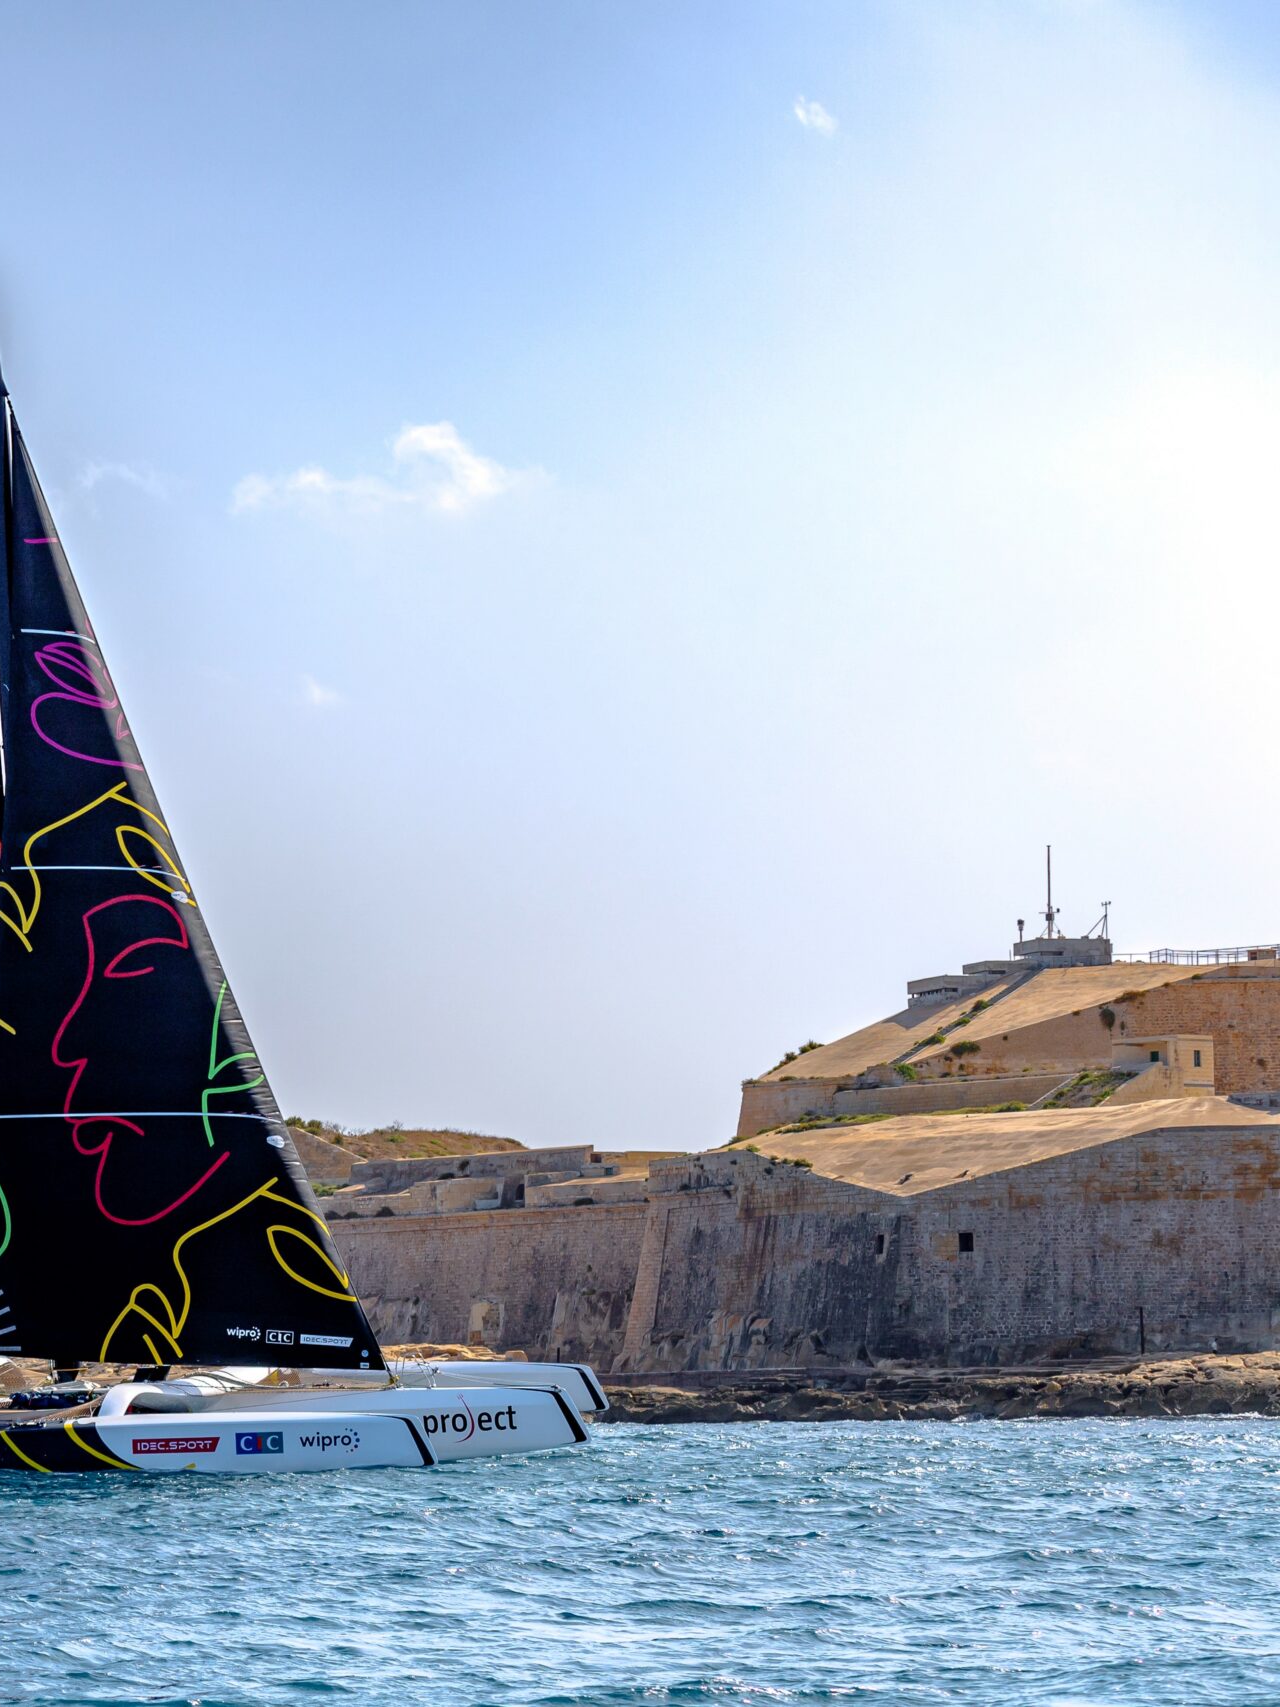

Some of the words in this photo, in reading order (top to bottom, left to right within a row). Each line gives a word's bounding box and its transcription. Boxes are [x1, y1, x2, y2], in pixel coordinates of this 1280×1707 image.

[226, 1327, 257, 1339] wipro
[269, 1332, 292, 1343] CIC
[303, 1337, 349, 1345] IDEC.SPORT
[423, 1393, 517, 1443] project
[137, 1440, 212, 1451] IDEC.SPORT
[240, 1436, 279, 1451] CIC
[299, 1432, 352, 1452] wipro
